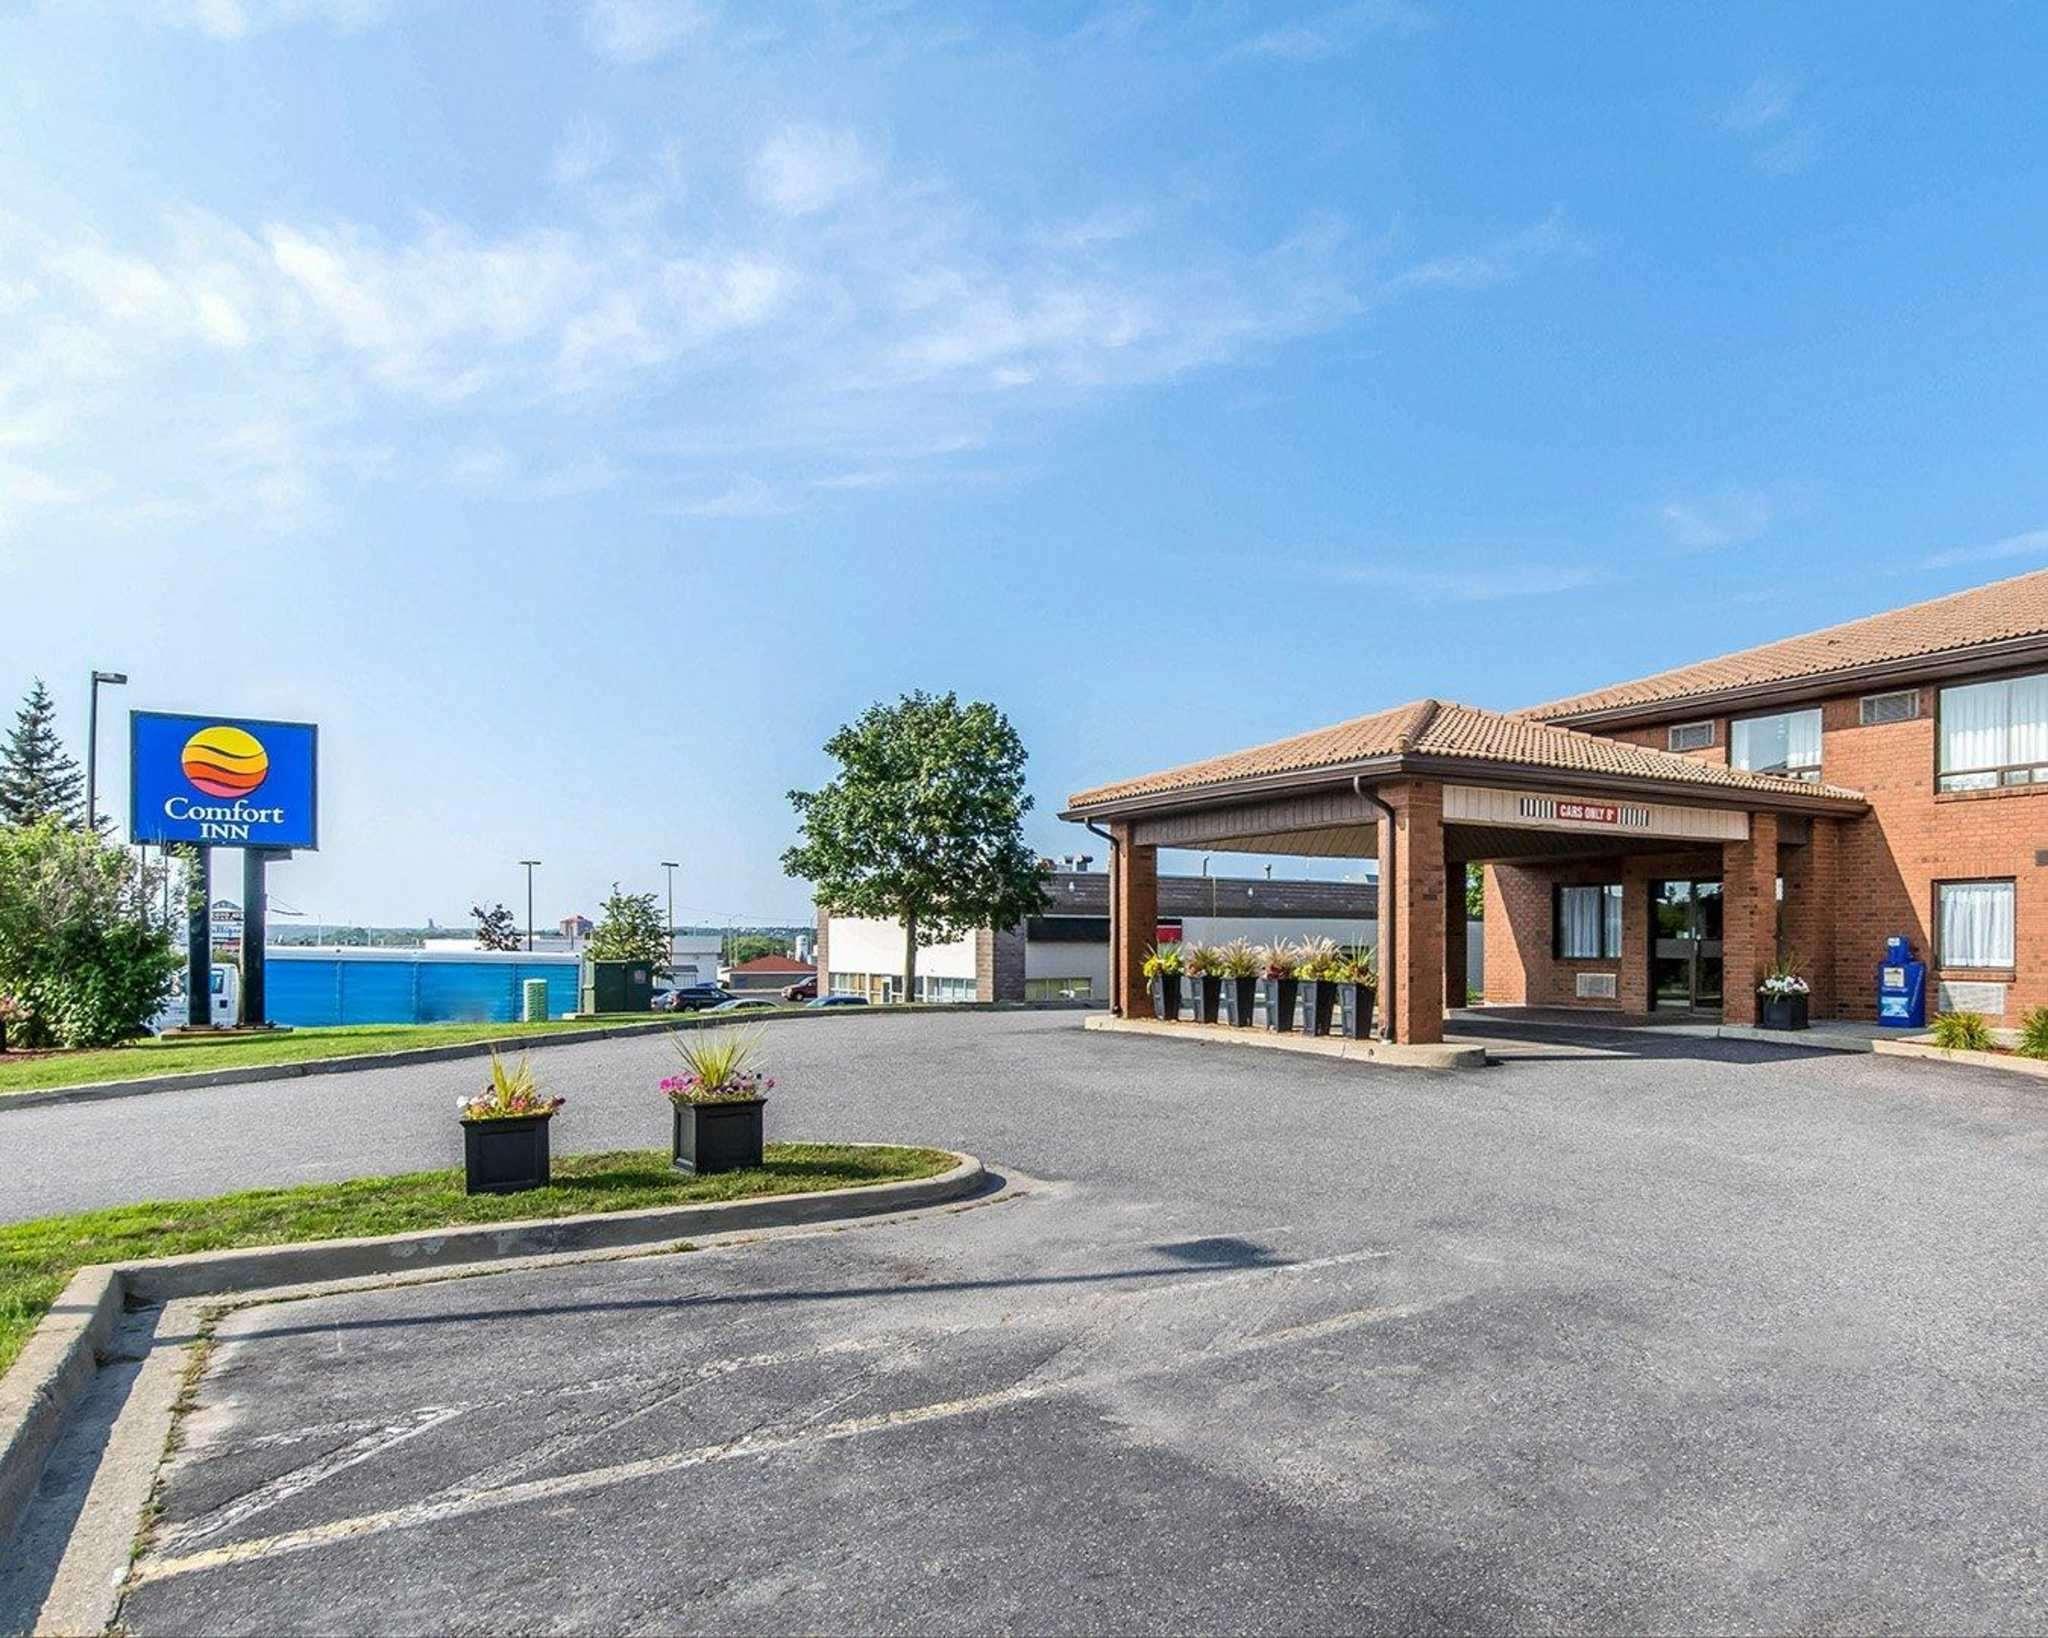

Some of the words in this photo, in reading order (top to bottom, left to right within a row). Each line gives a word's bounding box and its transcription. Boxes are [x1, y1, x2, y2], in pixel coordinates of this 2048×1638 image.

[164, 797, 284, 824] Comfort
[1560, 804, 1583, 819] CARS
[1584, 806, 1604, 820] ONLY
[200, 822, 249, 840] INN
